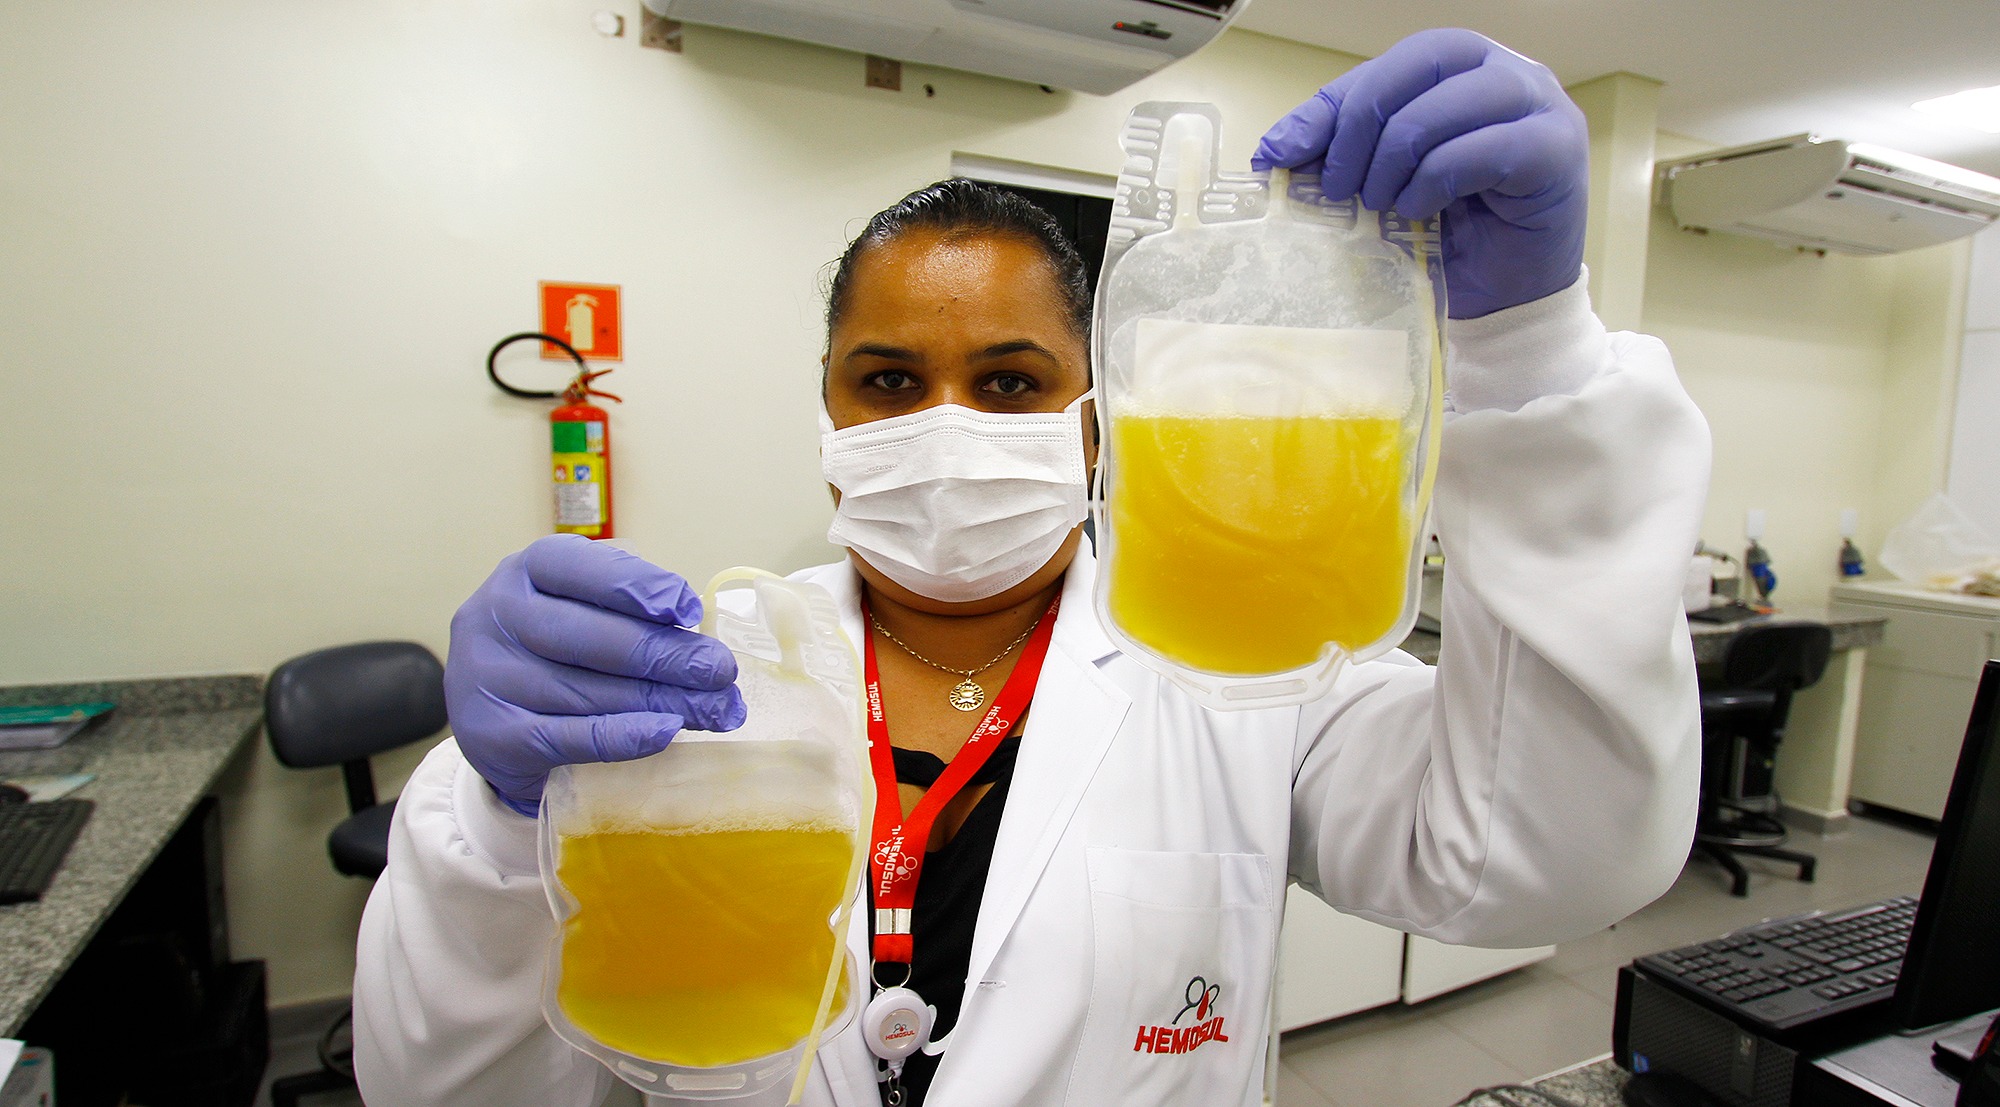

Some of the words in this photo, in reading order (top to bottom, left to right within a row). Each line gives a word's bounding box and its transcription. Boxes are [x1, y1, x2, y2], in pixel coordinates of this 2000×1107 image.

[868, 681, 883, 722] HEMOSUL
[968, 705, 1002, 744] HEMOSUL
[879, 836, 905, 898] HEMOSUL
[885, 1030, 915, 1041] HEMOSUL
[1133, 1016, 1229, 1055] HEMOSUL
